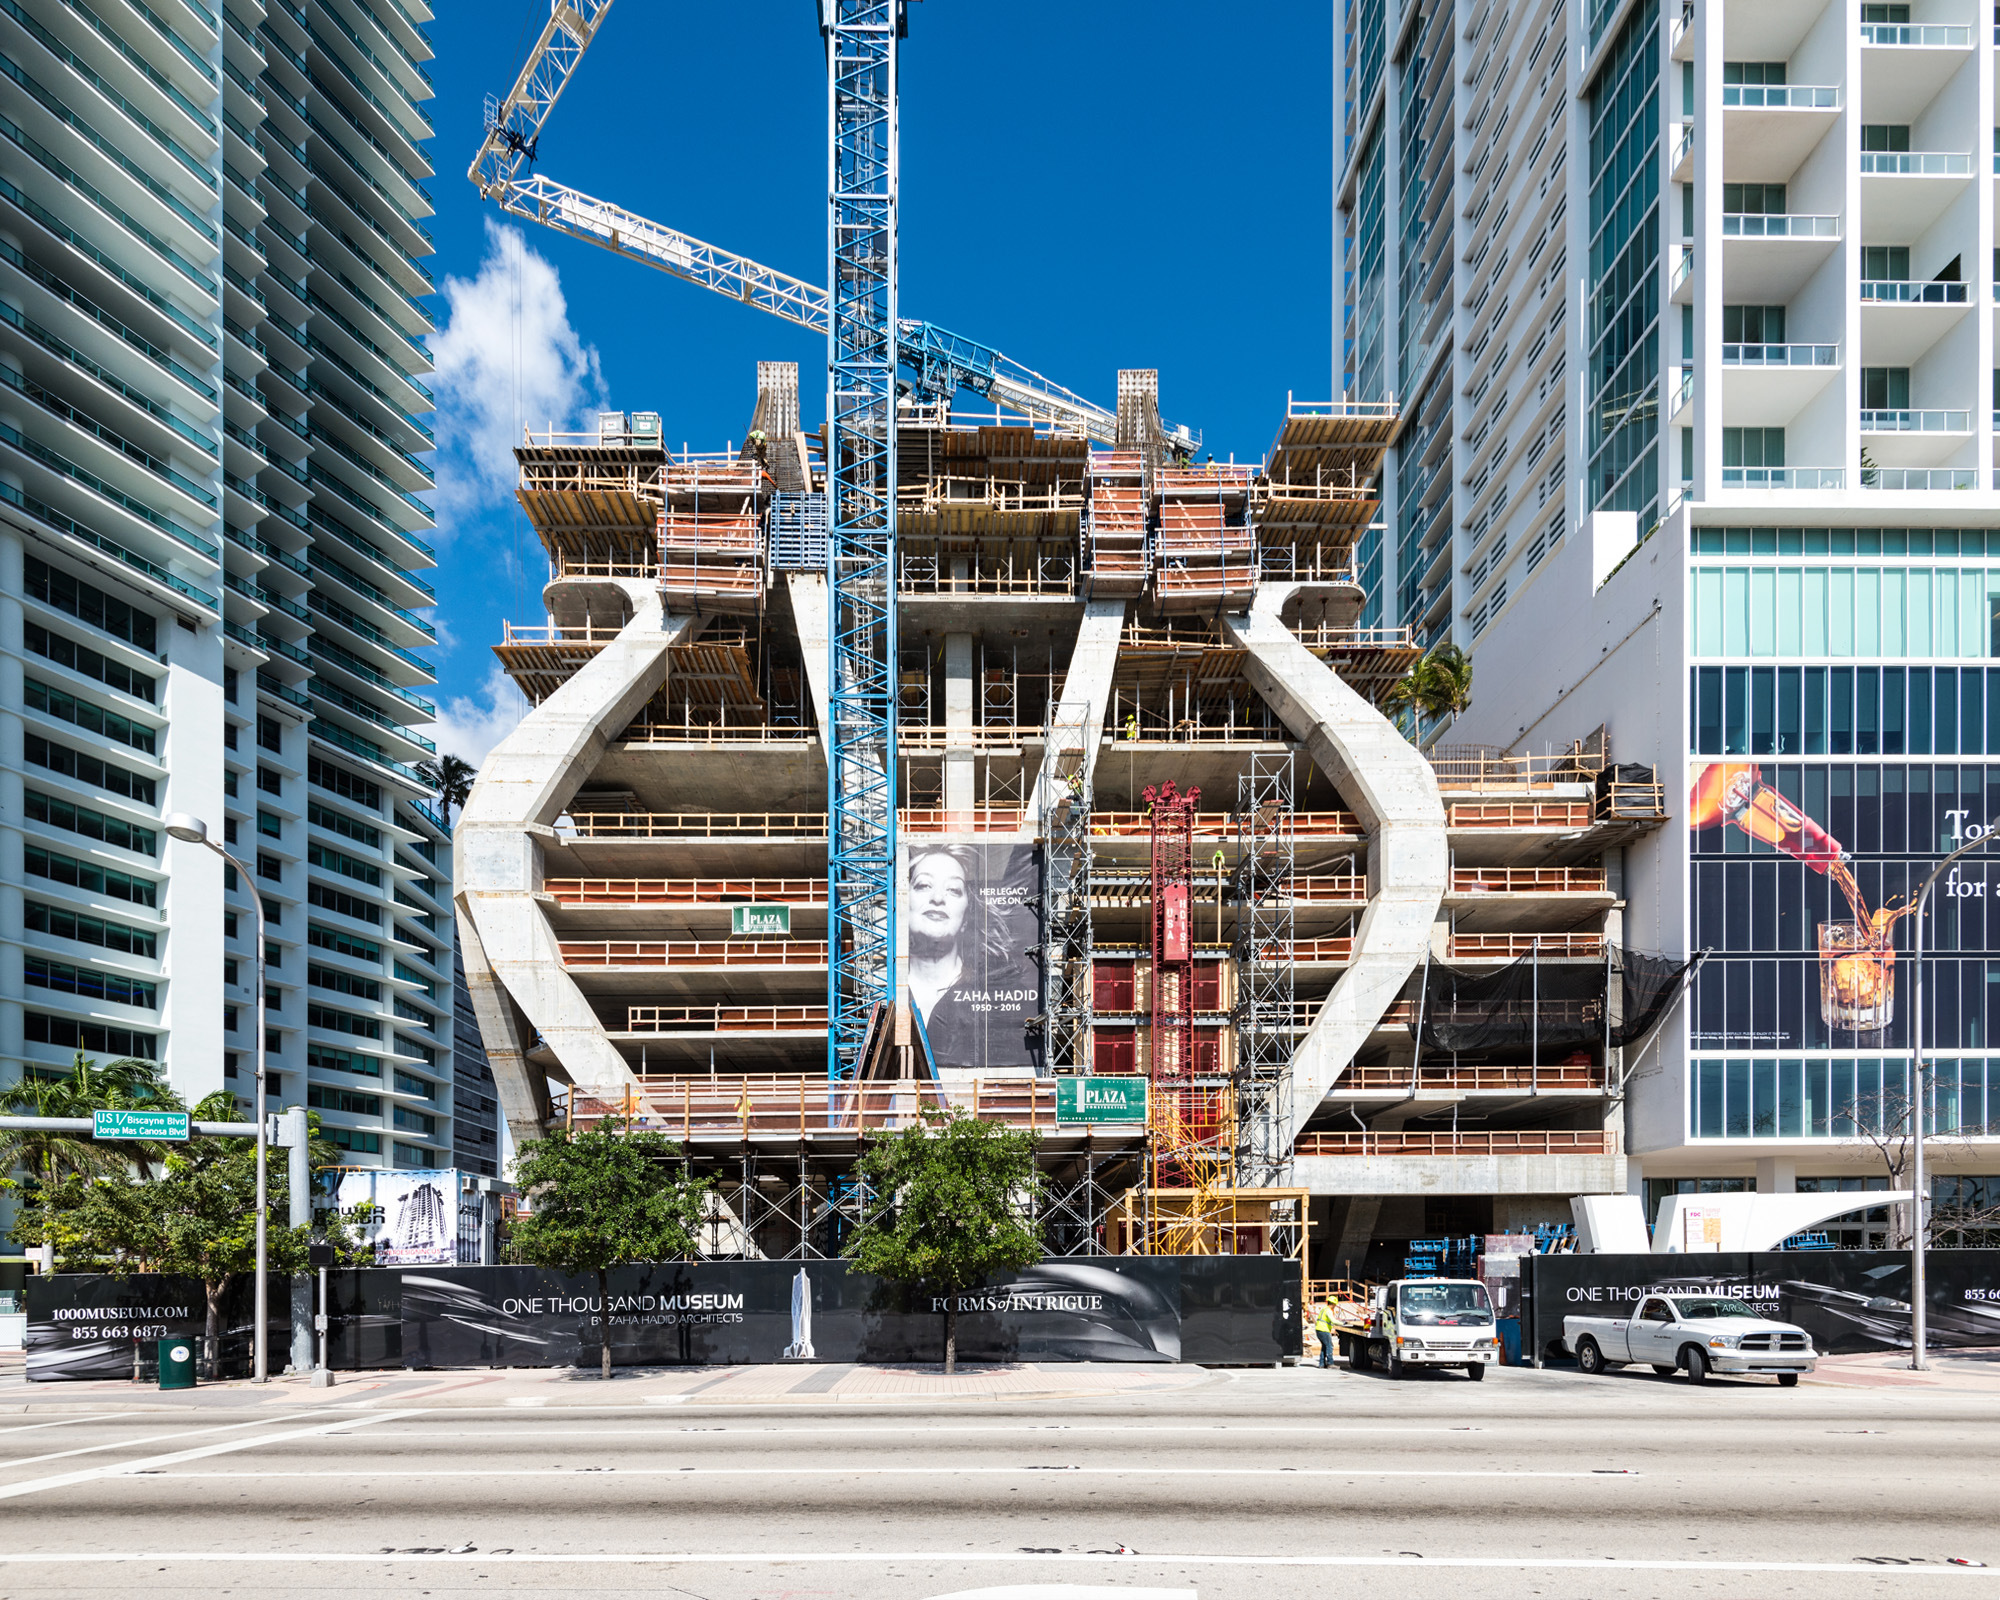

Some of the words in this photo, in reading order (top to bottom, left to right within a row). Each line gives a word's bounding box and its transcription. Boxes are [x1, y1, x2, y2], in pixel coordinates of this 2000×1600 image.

[1945, 810, 2000, 840] Tor
[1945, 867, 1987, 897] for
[979, 888, 995, 896] HER
[996, 887, 1028, 896] LEGACY
[986, 897, 1007, 905] LIVES
[750, 914, 781, 924] PLAZA
[1179, 899, 1187, 953] HOIST
[953, 990, 989, 1001] ZAHA
[995, 990, 1038, 1001] HADID
[1086, 1090, 1126, 1104] PLAZA
[97, 1113, 113, 1124] US
[167, 1117, 185, 1125] Blvd
[97, 1126, 120, 1136] Jorge
[122, 1127, 137, 1135] Mas
[139, 1127, 167, 1135] Canosa
[168, 1128, 186, 1136] Blvd
[1566, 1287, 1602, 1302] ONE
[1705, 1285, 1780, 1299] MUSEUM
[1964, 1289, 1986, 1300] 855
[502, 1298, 543, 1314] ONE
[547, 1295, 656, 1314] THOUSAND
[660, 1293, 743, 1310] MUSEUM
[997, 1292, 1014, 1312] of
[1012, 1295, 1102, 1310] INTRIGUE
[1722, 1302, 1780, 1312] ARCTECTS
[52, 1306, 189, 1321] 1000MUSEUM.COM
[608, 1315, 640, 1325] ZAHA
[641, 1314, 676, 1325] HADID
[678, 1313, 743, 1324] ARCHITECTS
[72, 1326, 98, 1339] 855
[102, 1326, 128, 1338] 663
[132, 1325, 168, 1338] 6873
